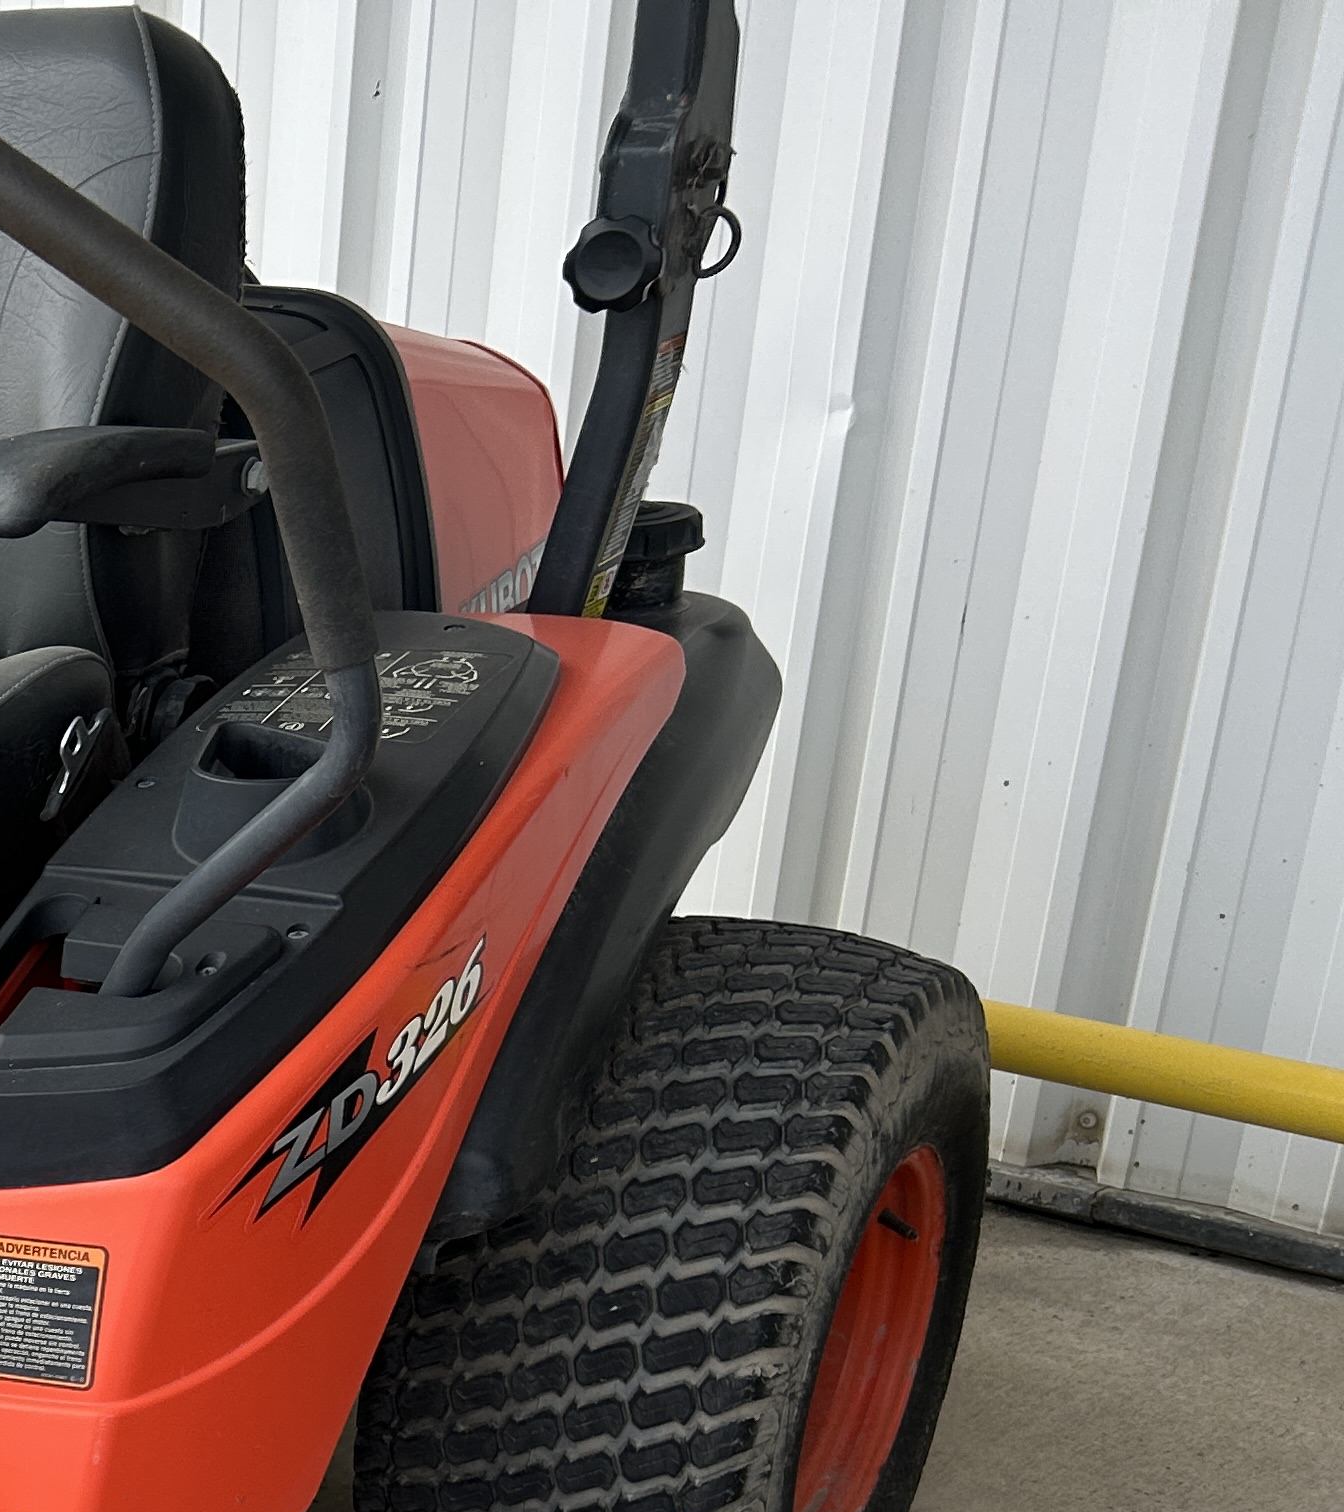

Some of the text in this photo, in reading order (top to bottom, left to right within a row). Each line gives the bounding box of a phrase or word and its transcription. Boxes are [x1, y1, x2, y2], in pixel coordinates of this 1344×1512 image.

[1, 1257, 34, 1269] EVITAR
[35, 1261, 83, 1275] LESIONES
[36, 1269, 76, 1282] GRAVES
